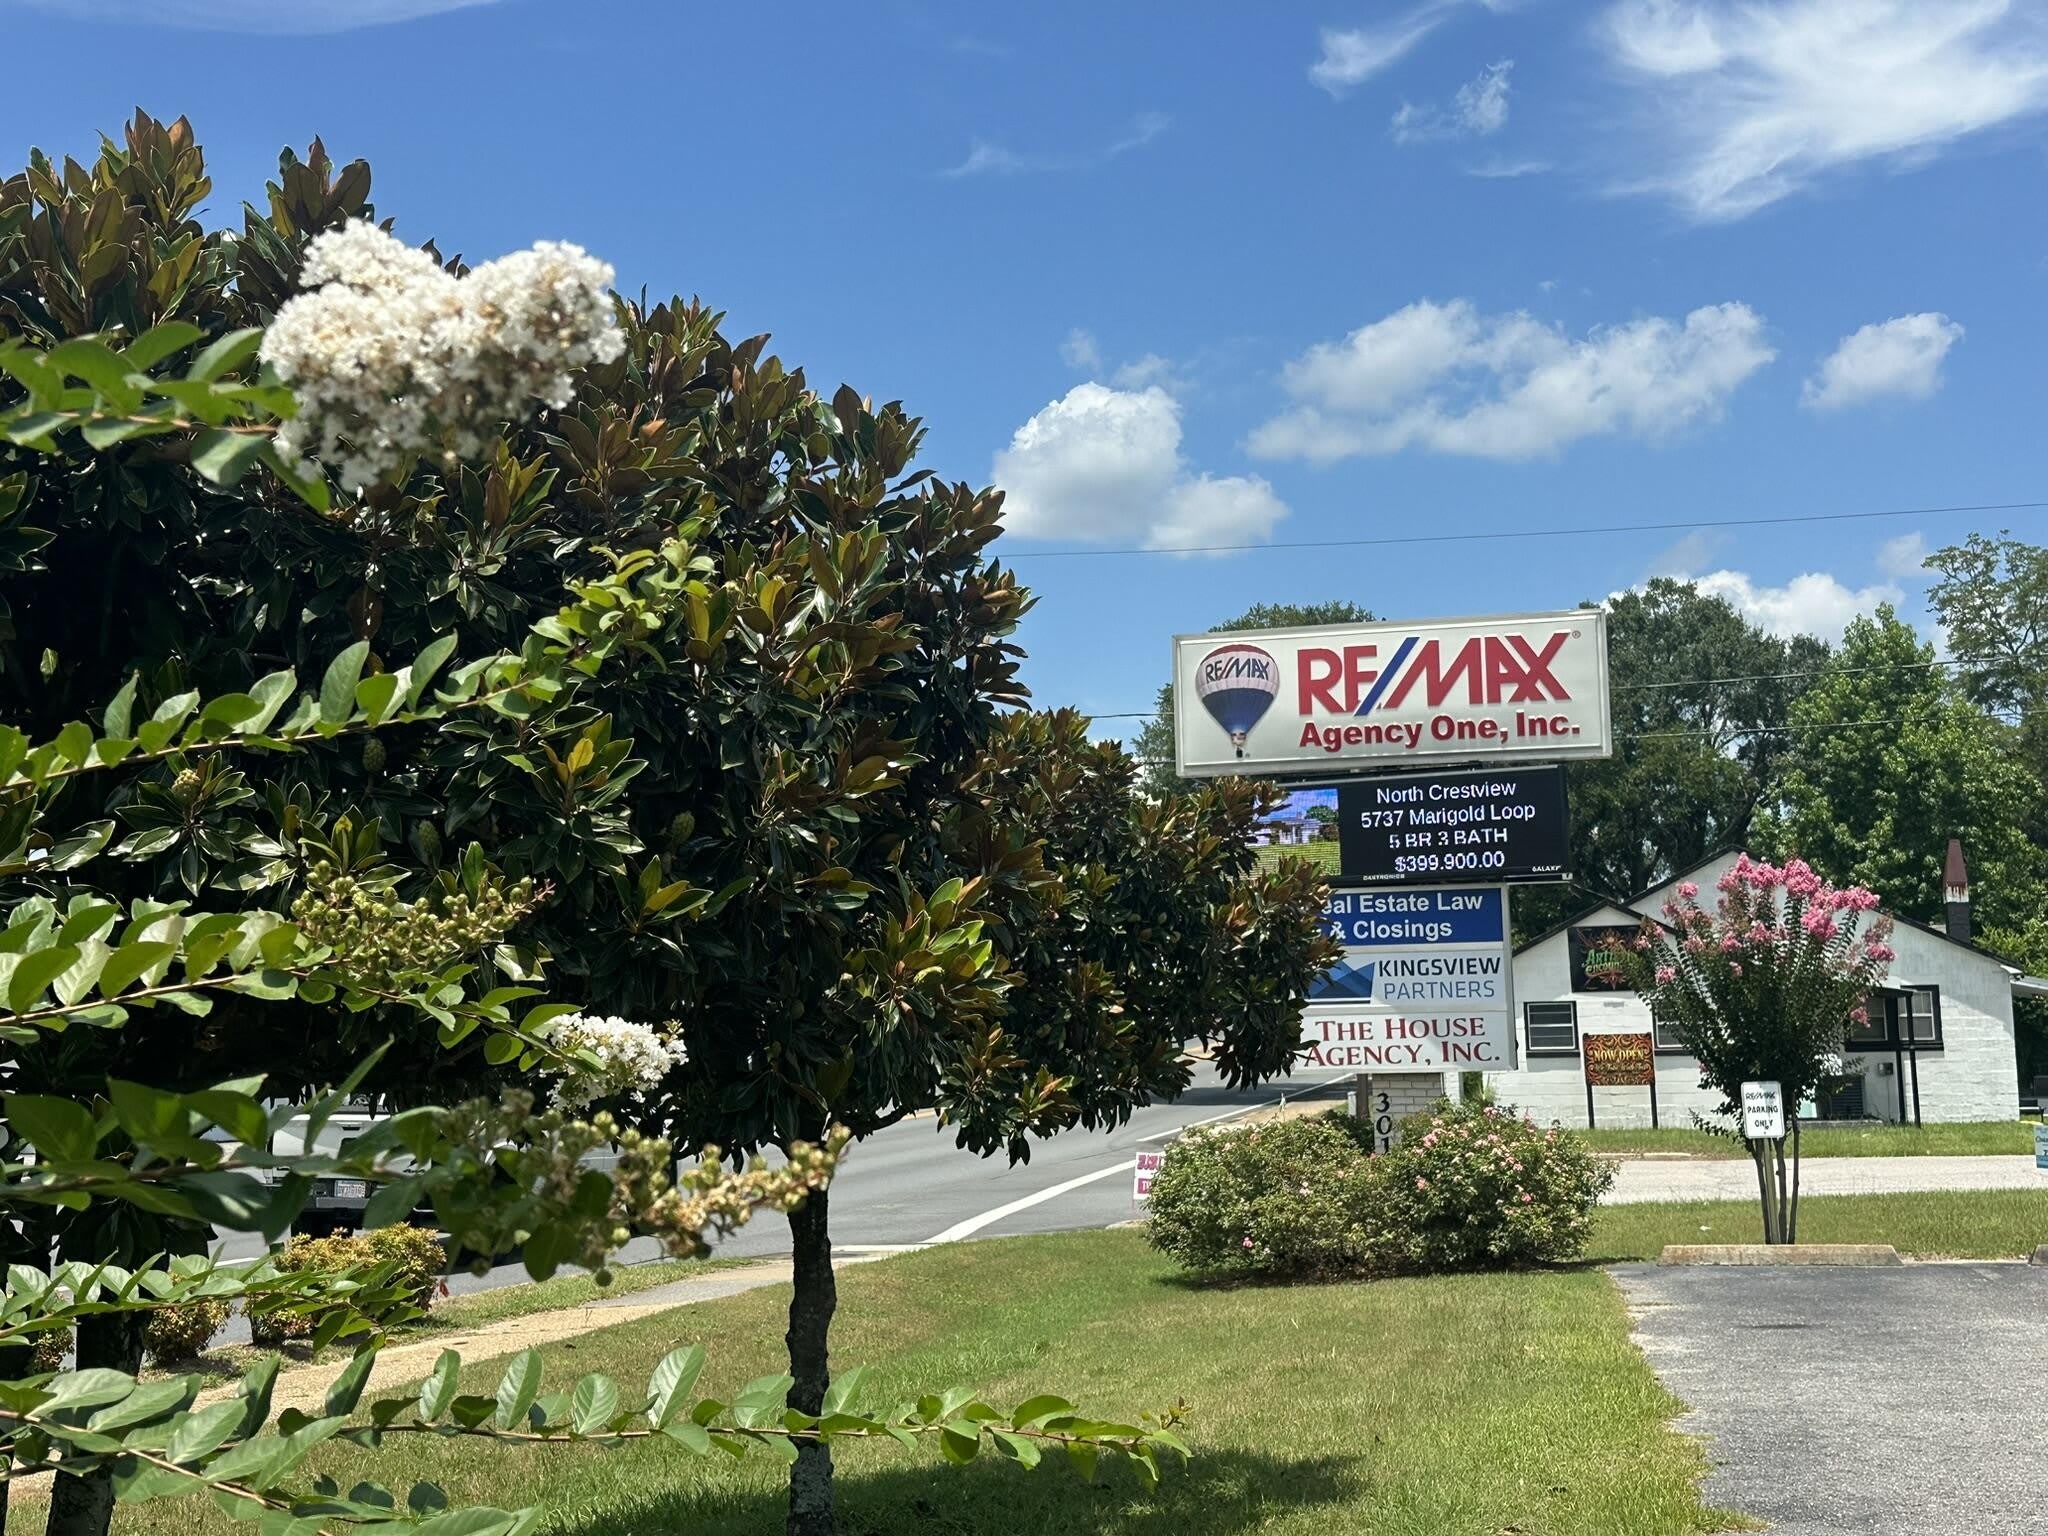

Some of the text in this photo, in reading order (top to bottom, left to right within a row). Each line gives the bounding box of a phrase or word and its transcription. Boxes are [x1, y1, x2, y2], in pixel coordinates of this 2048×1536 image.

[1205, 656, 1270, 682] RE/MAX
[1296, 631, 1573, 716] RE/MAX
[1299, 711, 1581, 753] Agency One, Inc.
[1376, 781, 1516, 803] North Crestview
[1360, 803, 1536, 828] 5737 Marigold Loop
[1388, 828, 1508, 848] 5 BR 3 BATH
[1321, 892, 1483, 915] eal Estate Law
[1329, 919, 1453, 941] & Closings
[1378, 956, 1501, 977] KINGSVIEW
[1383, 980, 1495, 1000] PARTNERS
[1315, 1017, 1486, 1042] THE HOUSE
[1304, 1041, 1500, 1067] AGENCY, INC.
[1593, 1048, 1645, 1062] NOW OPEN
[1746, 1105, 1779, 1114] PARKING
[1754, 1119, 1774, 1129] ONLY
